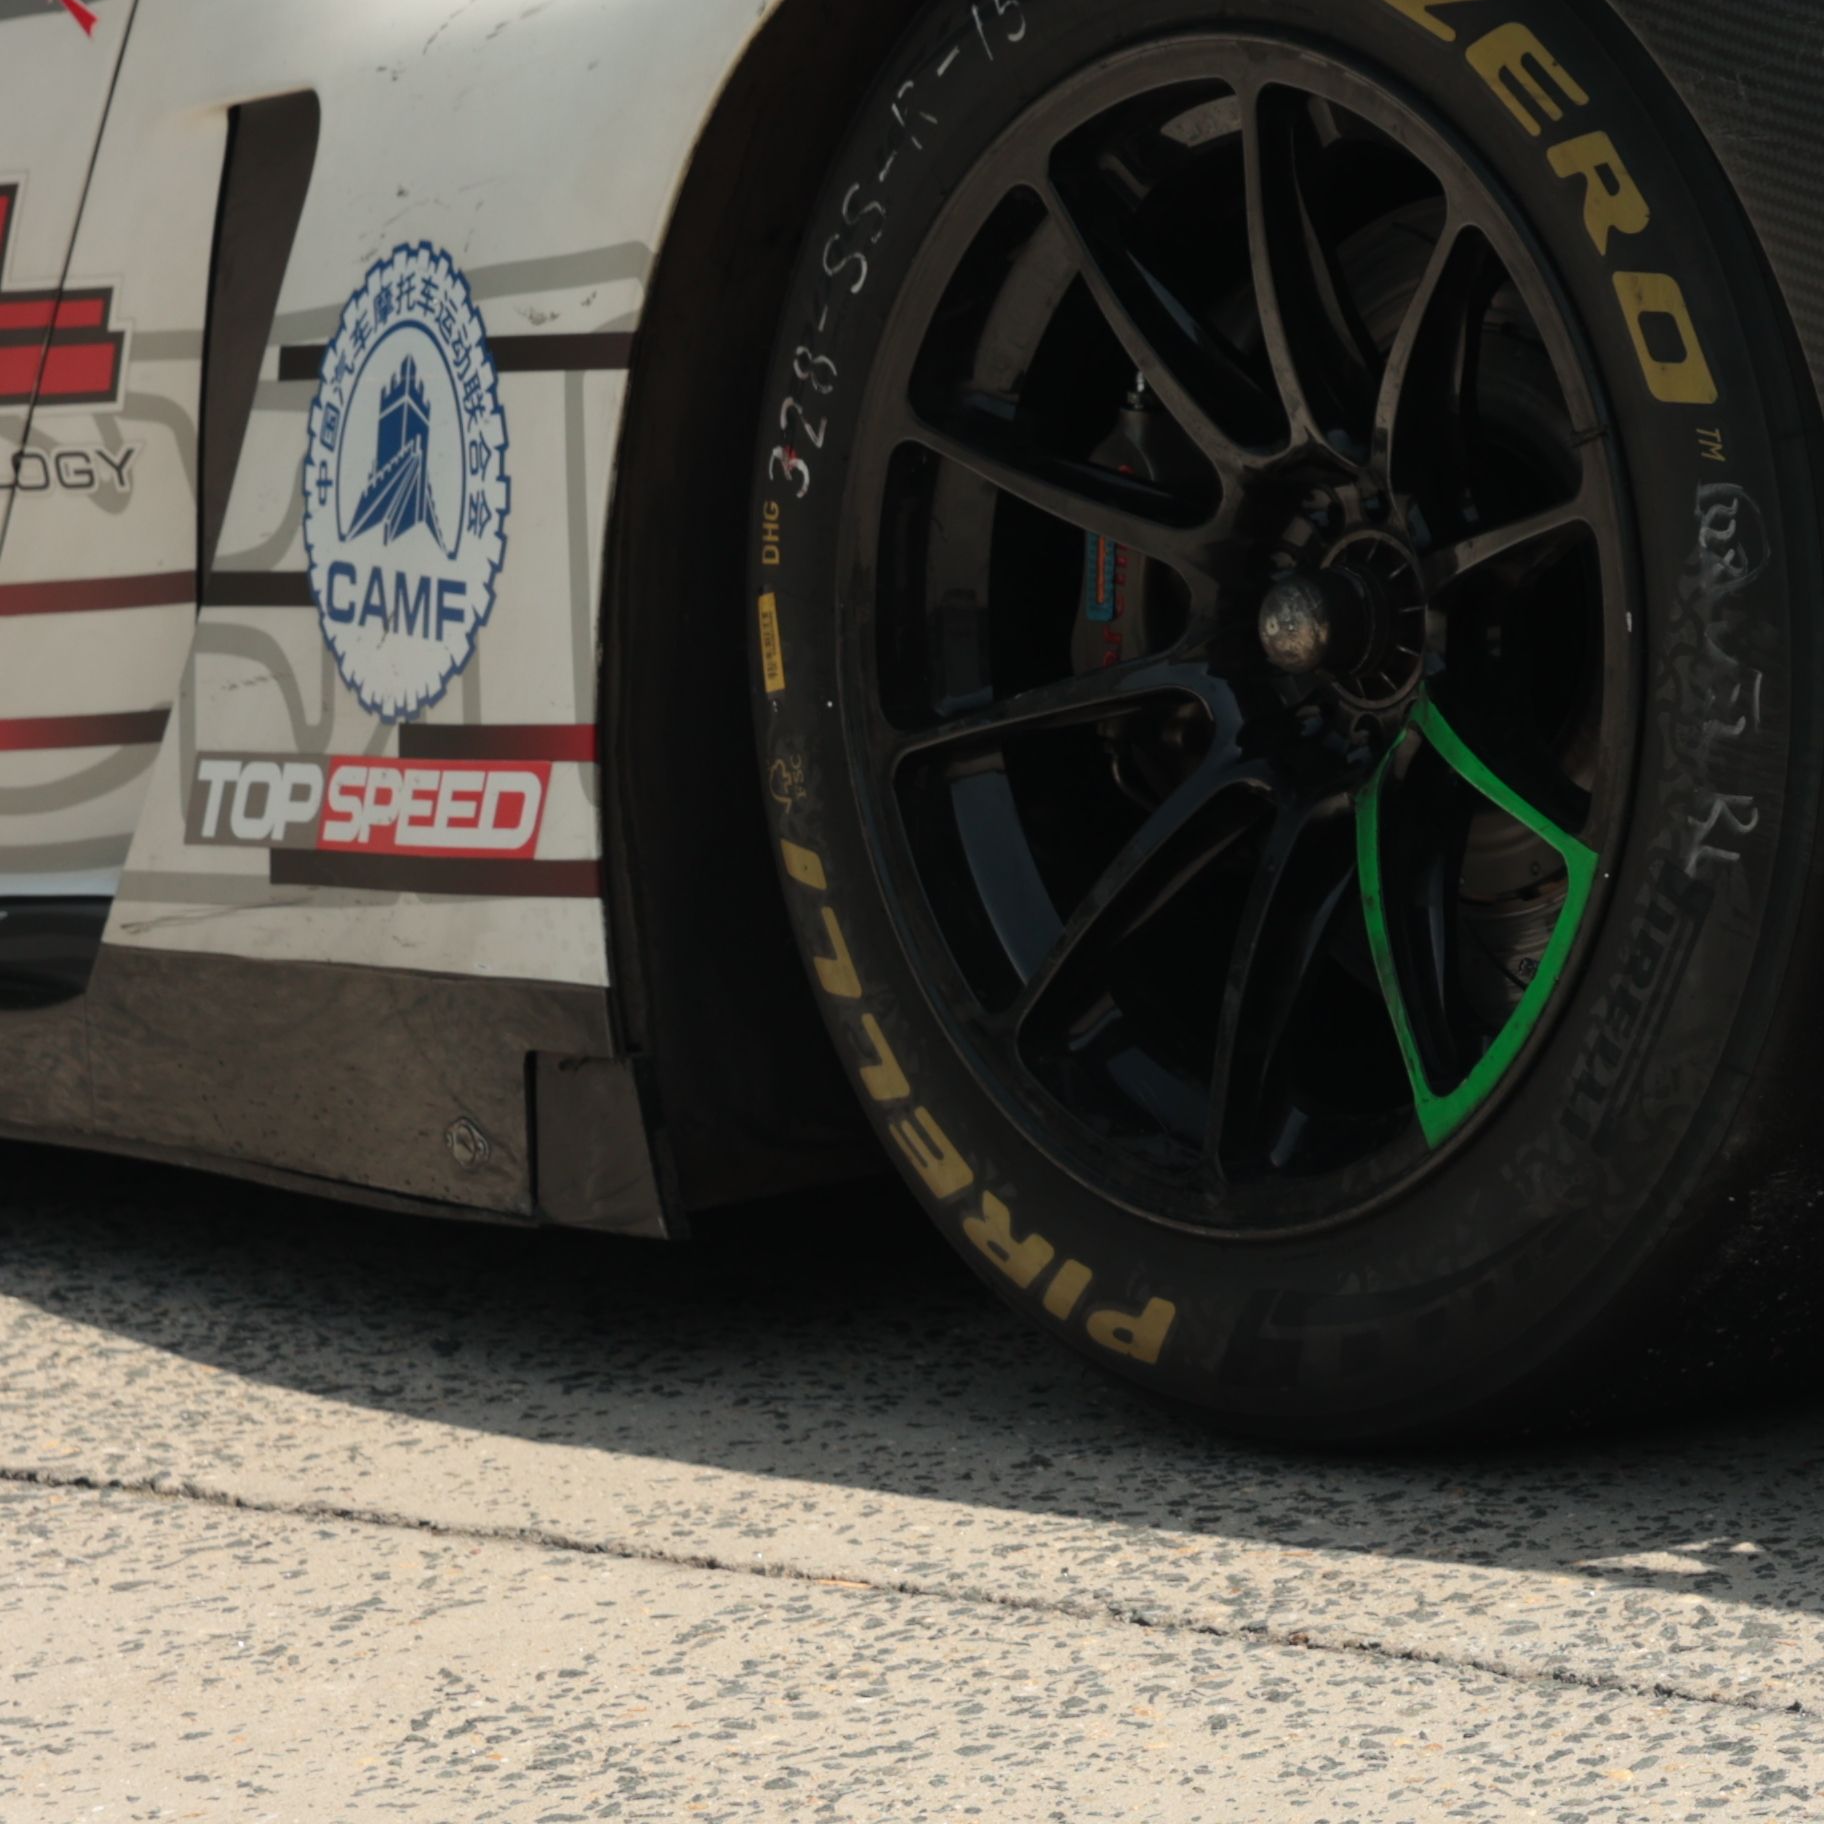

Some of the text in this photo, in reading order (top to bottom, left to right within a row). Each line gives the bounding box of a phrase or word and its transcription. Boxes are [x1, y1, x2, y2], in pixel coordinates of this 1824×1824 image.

[762, 499, 780, 565] DHG
[325, 560, 468, 642] CAMF
[781, 837, 1177, 1365] PIRELLI
